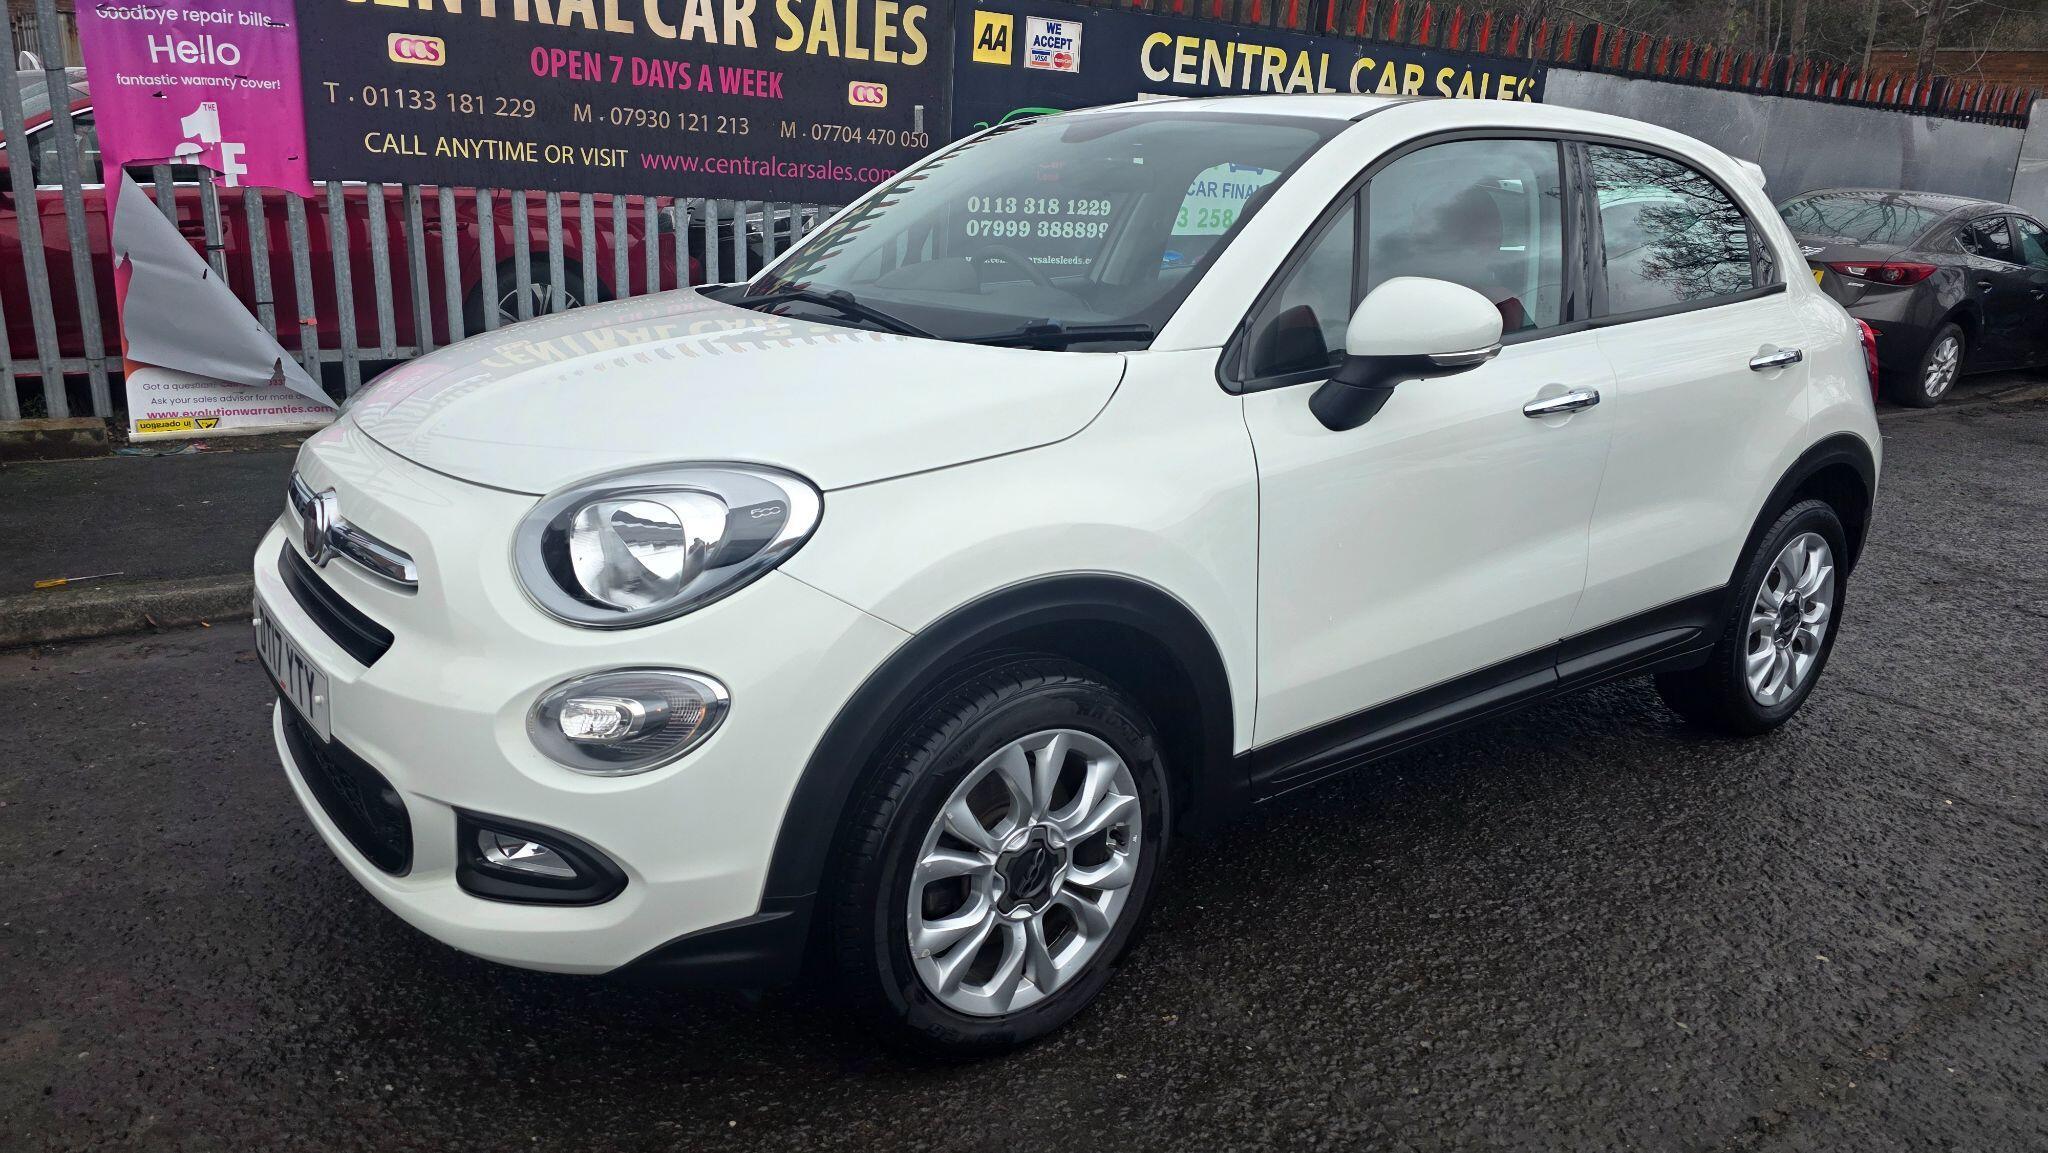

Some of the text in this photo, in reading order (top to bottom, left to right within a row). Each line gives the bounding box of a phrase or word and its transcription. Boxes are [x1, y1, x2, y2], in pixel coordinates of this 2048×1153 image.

[96, 4, 179, 24] Goodbye
[182, 9, 234, 26] repair
[775, 0, 928, 65] SALES
[977, 23, 1007, 52] AA
[1046, 22, 1062, 35] WE
[147, 34, 241, 66] Hello
[1033, 35, 1072, 50] ACCEPT
[530, 47, 784, 99] OPEN 7 DAYS A WEEK
[1140, 31, 1337, 94] CENTRAL
[1349, 57, 1426, 96] CAR
[117, 73, 281, 90] fantastic warranty cover!
[362, 85, 437, 111] 01133
[447, 92, 484, 115] 181
[493, 97, 536, 118] 229
[610, 107, 670, 129] 07930
[678, 112, 708, 132] 121
[716, 116, 749, 135] 213
[811, 124, 862, 144] 07704
[867, 128, 895, 146] 470
[901, 132, 929, 149] 050
[364, 132, 427, 156] CALL
[435, 136, 537, 163] ANYTIME
[544, 144, 574, 165] OR
[580, 148, 629, 168] VISIT
[1186, 181, 1218, 198] CAR
[967, 196, 1111, 216] 0113 318 1229
[966, 219, 1031, 237] 07999
[142, 383, 161, 391] Got
[151, 397, 167, 405] Ask
[171, 397, 190, 406] your
[193, 395, 217, 404] sales
[219, 393, 253, 403] advisor
[256, 393, 267, 401] for
